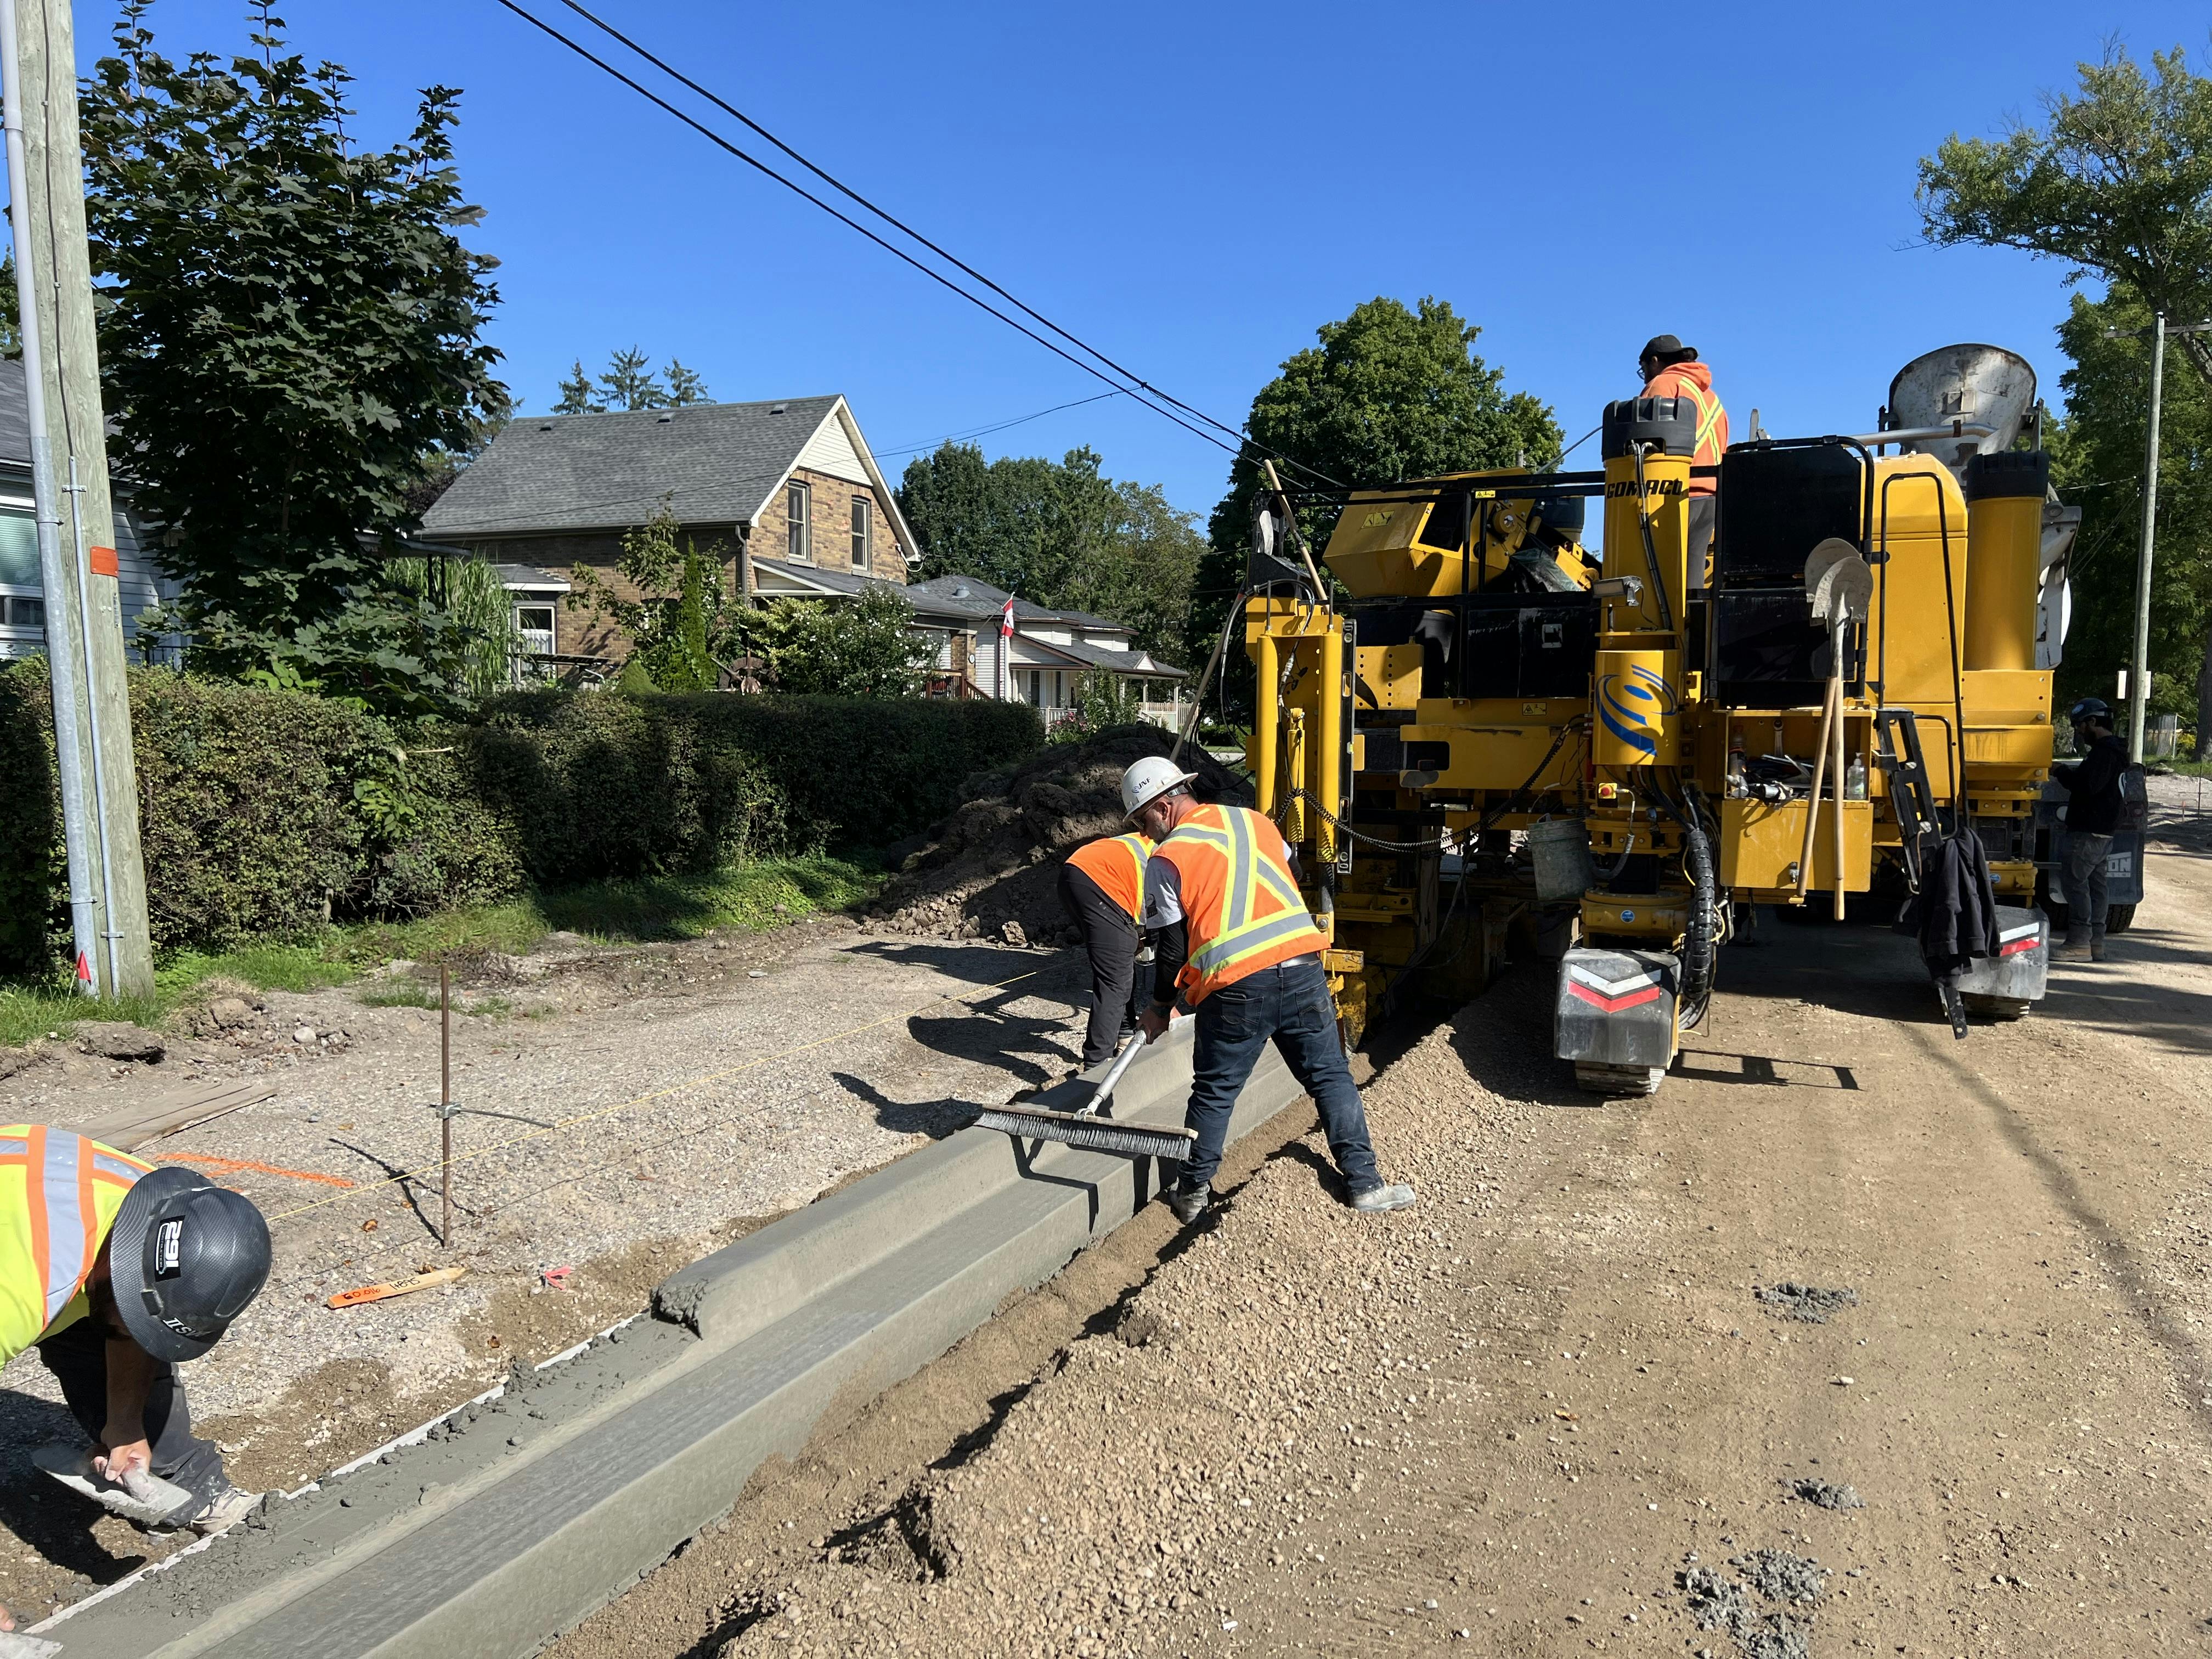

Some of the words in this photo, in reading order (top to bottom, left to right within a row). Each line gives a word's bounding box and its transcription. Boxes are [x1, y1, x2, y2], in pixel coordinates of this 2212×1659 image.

[1607, 479, 1683, 498] GOMACO
[2106, 857, 2131, 872] ON
[166, 1221, 183, 1267] 291
